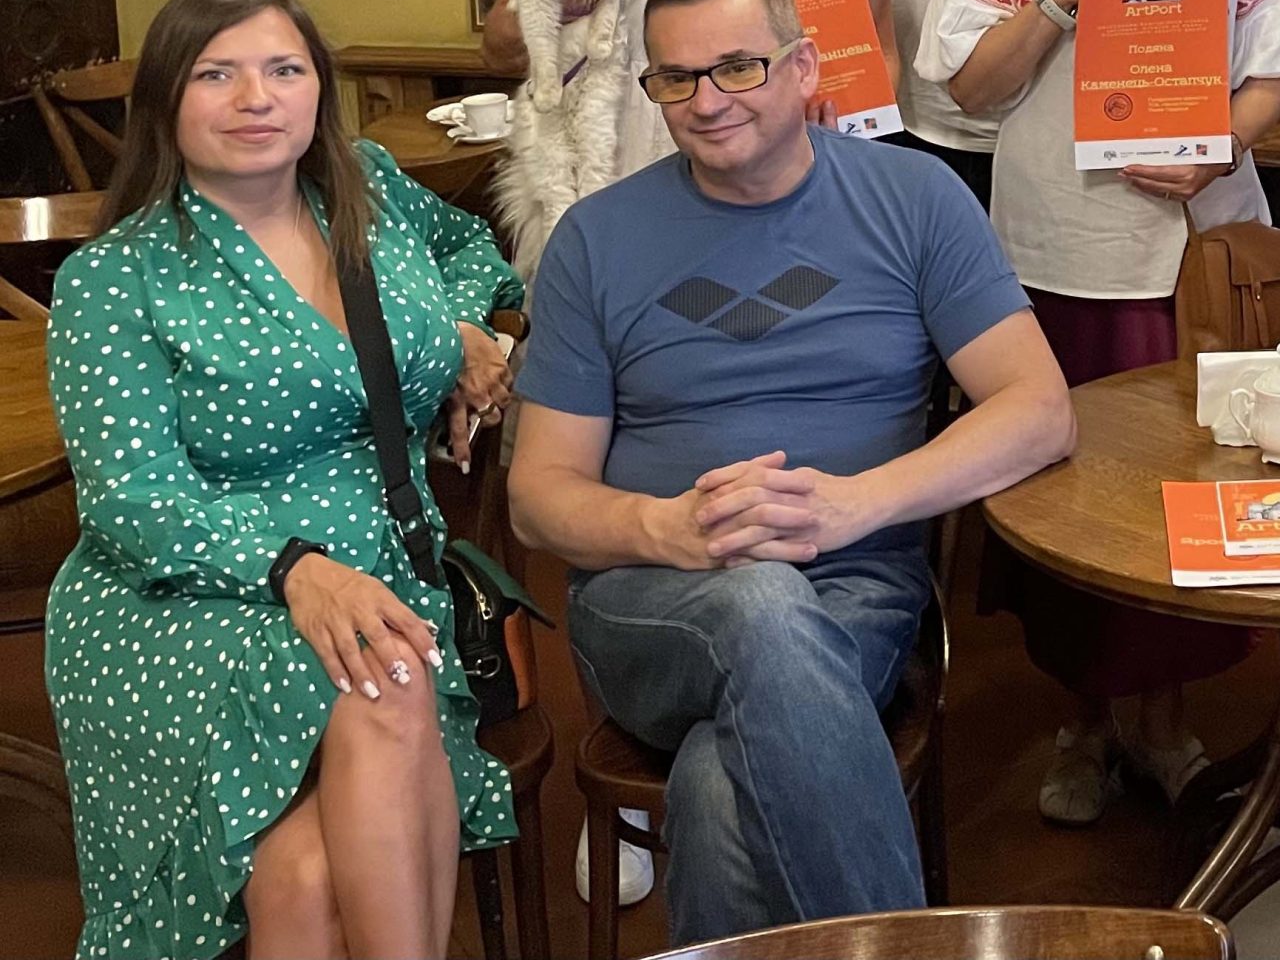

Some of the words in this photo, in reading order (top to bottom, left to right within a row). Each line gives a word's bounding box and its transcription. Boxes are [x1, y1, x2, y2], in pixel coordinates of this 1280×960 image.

[1125, 2, 1182, 17] ArtPort
[819, 42, 873, 63] анцева
[1128, 43, 1174, 54] Подяка
[1129, 64, 1173, 74] Олена
